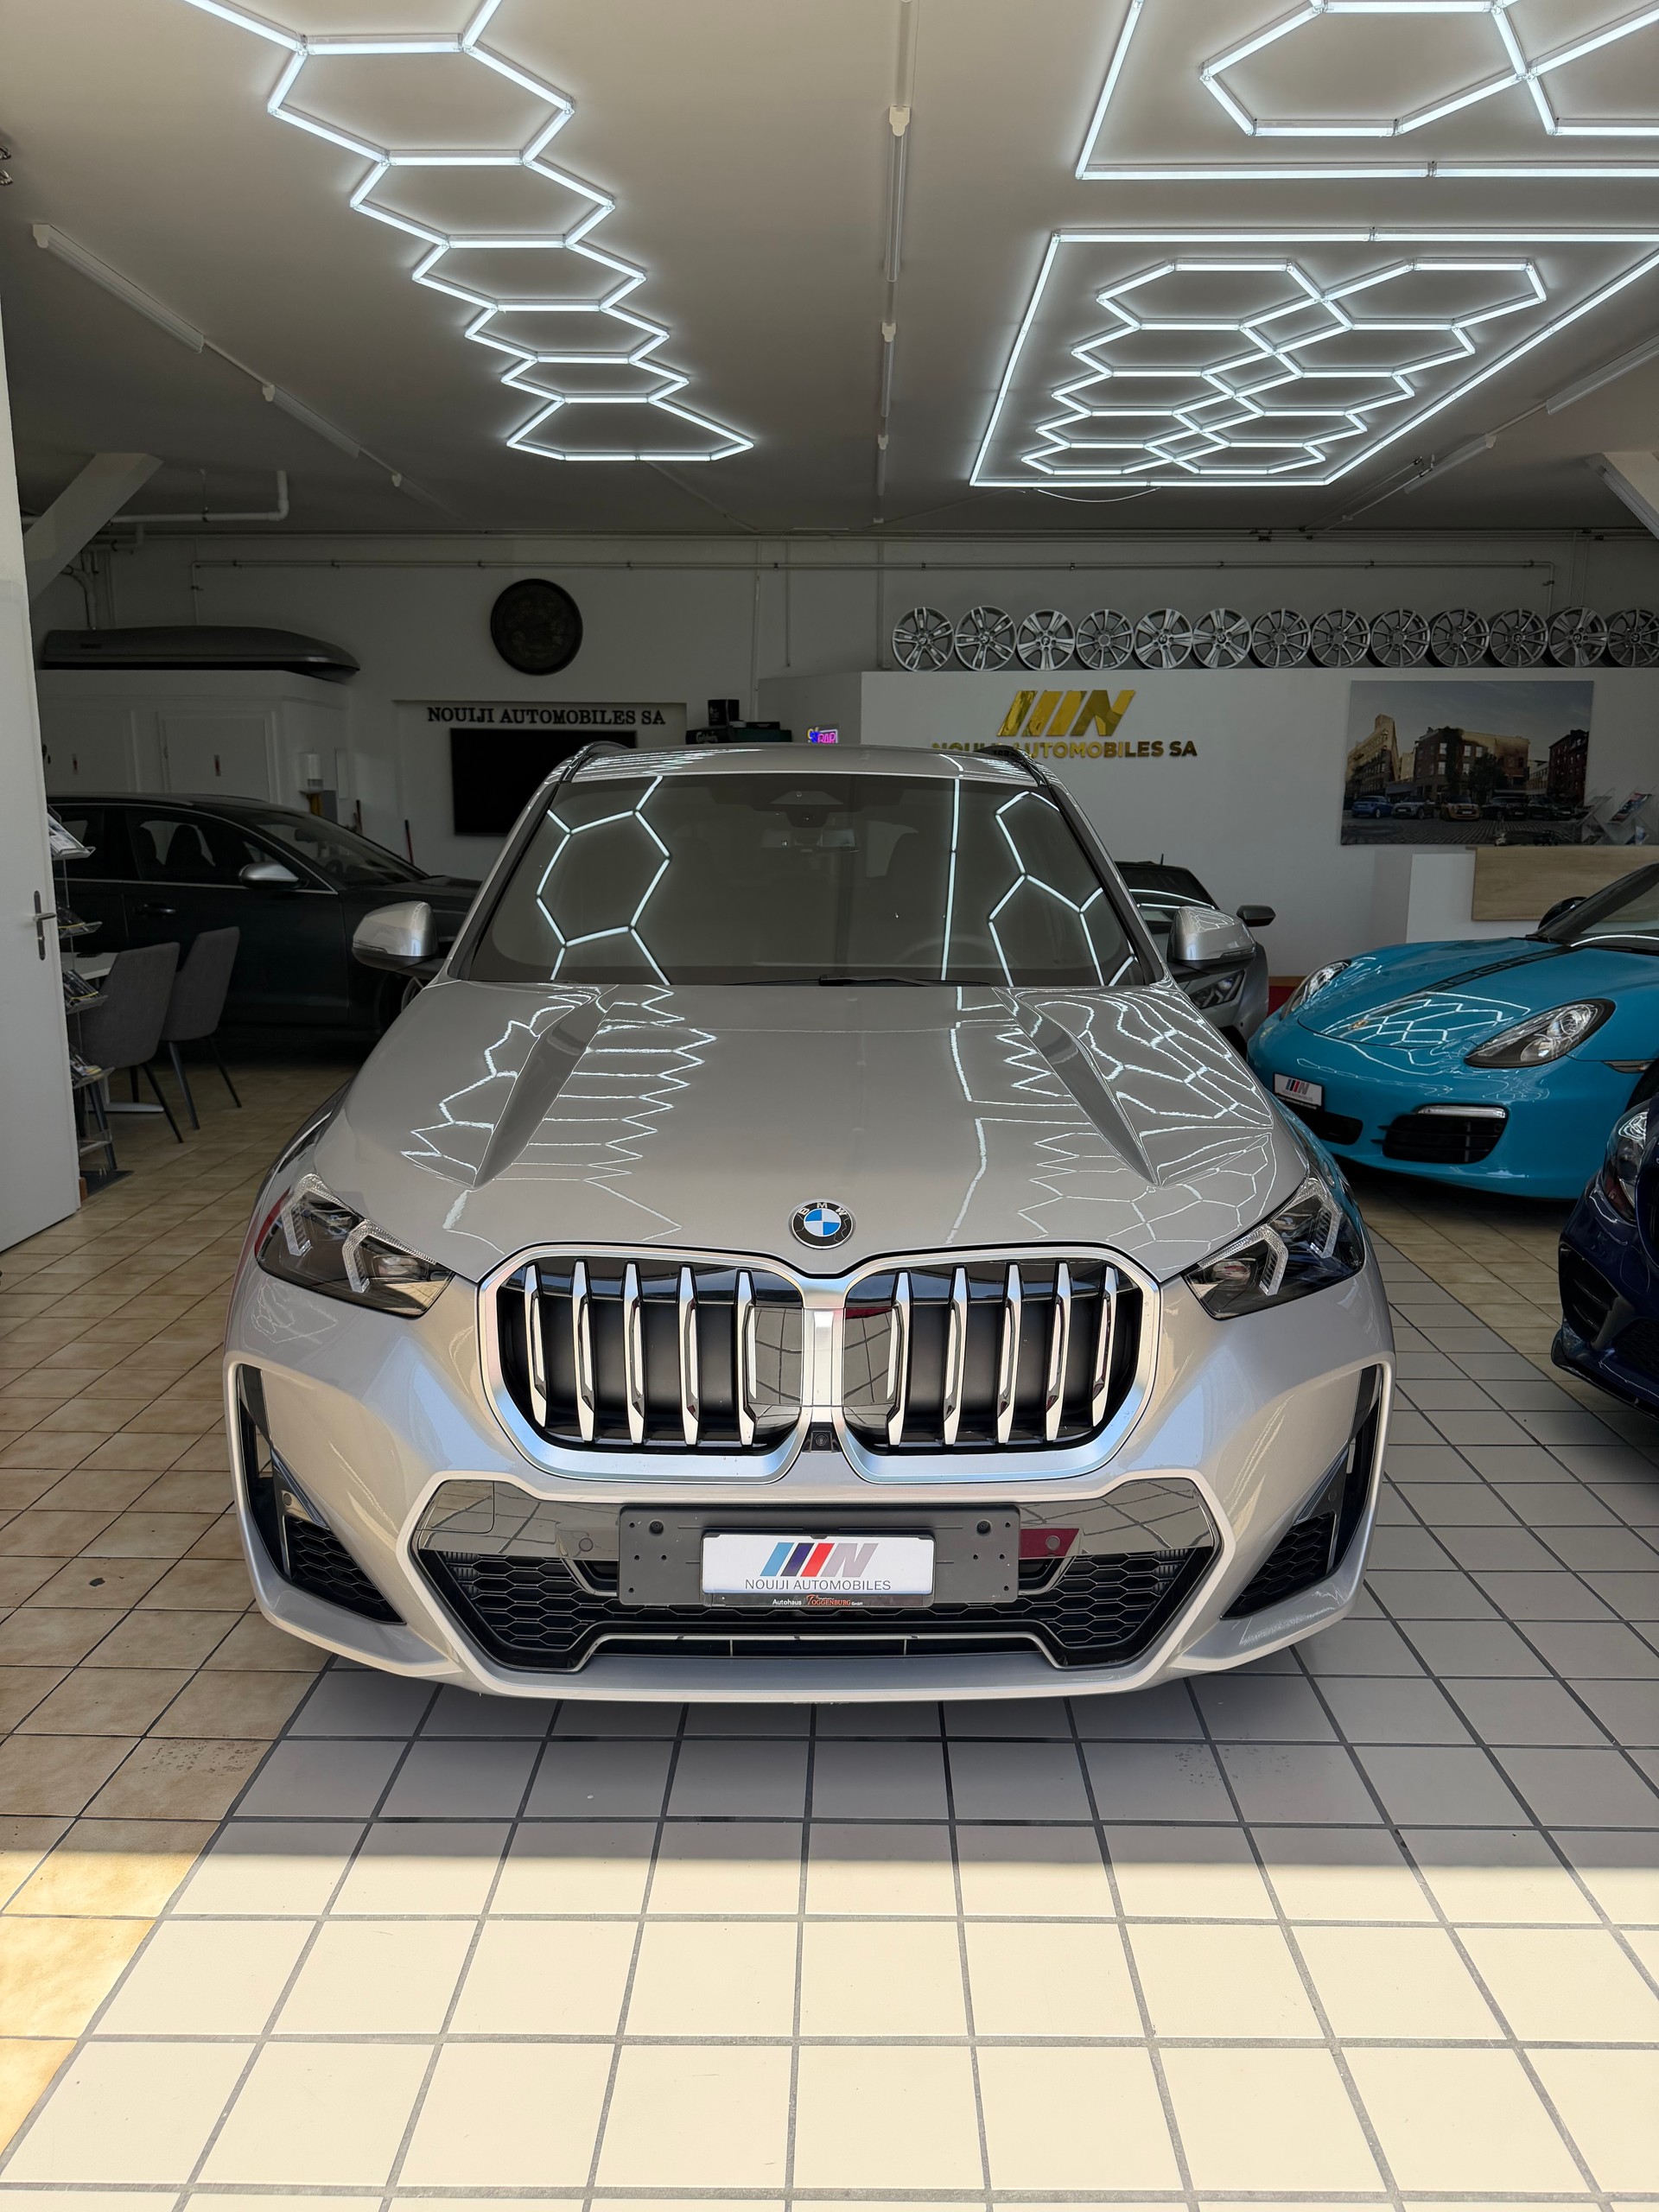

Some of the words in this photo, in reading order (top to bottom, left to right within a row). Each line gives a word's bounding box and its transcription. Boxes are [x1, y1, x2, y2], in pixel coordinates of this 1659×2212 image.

[427, 707, 495, 723] NOUIJI
[499, 709, 636, 725] AUTOMOBILES
[641, 709, 666, 725] SA
[1169, 741, 1198, 757] SA
[798, 1202, 848, 1216] BMW
[745, 1579, 789, 1590] NOUIJI
[793, 1580, 891, 1591] AUTOMOBILES
